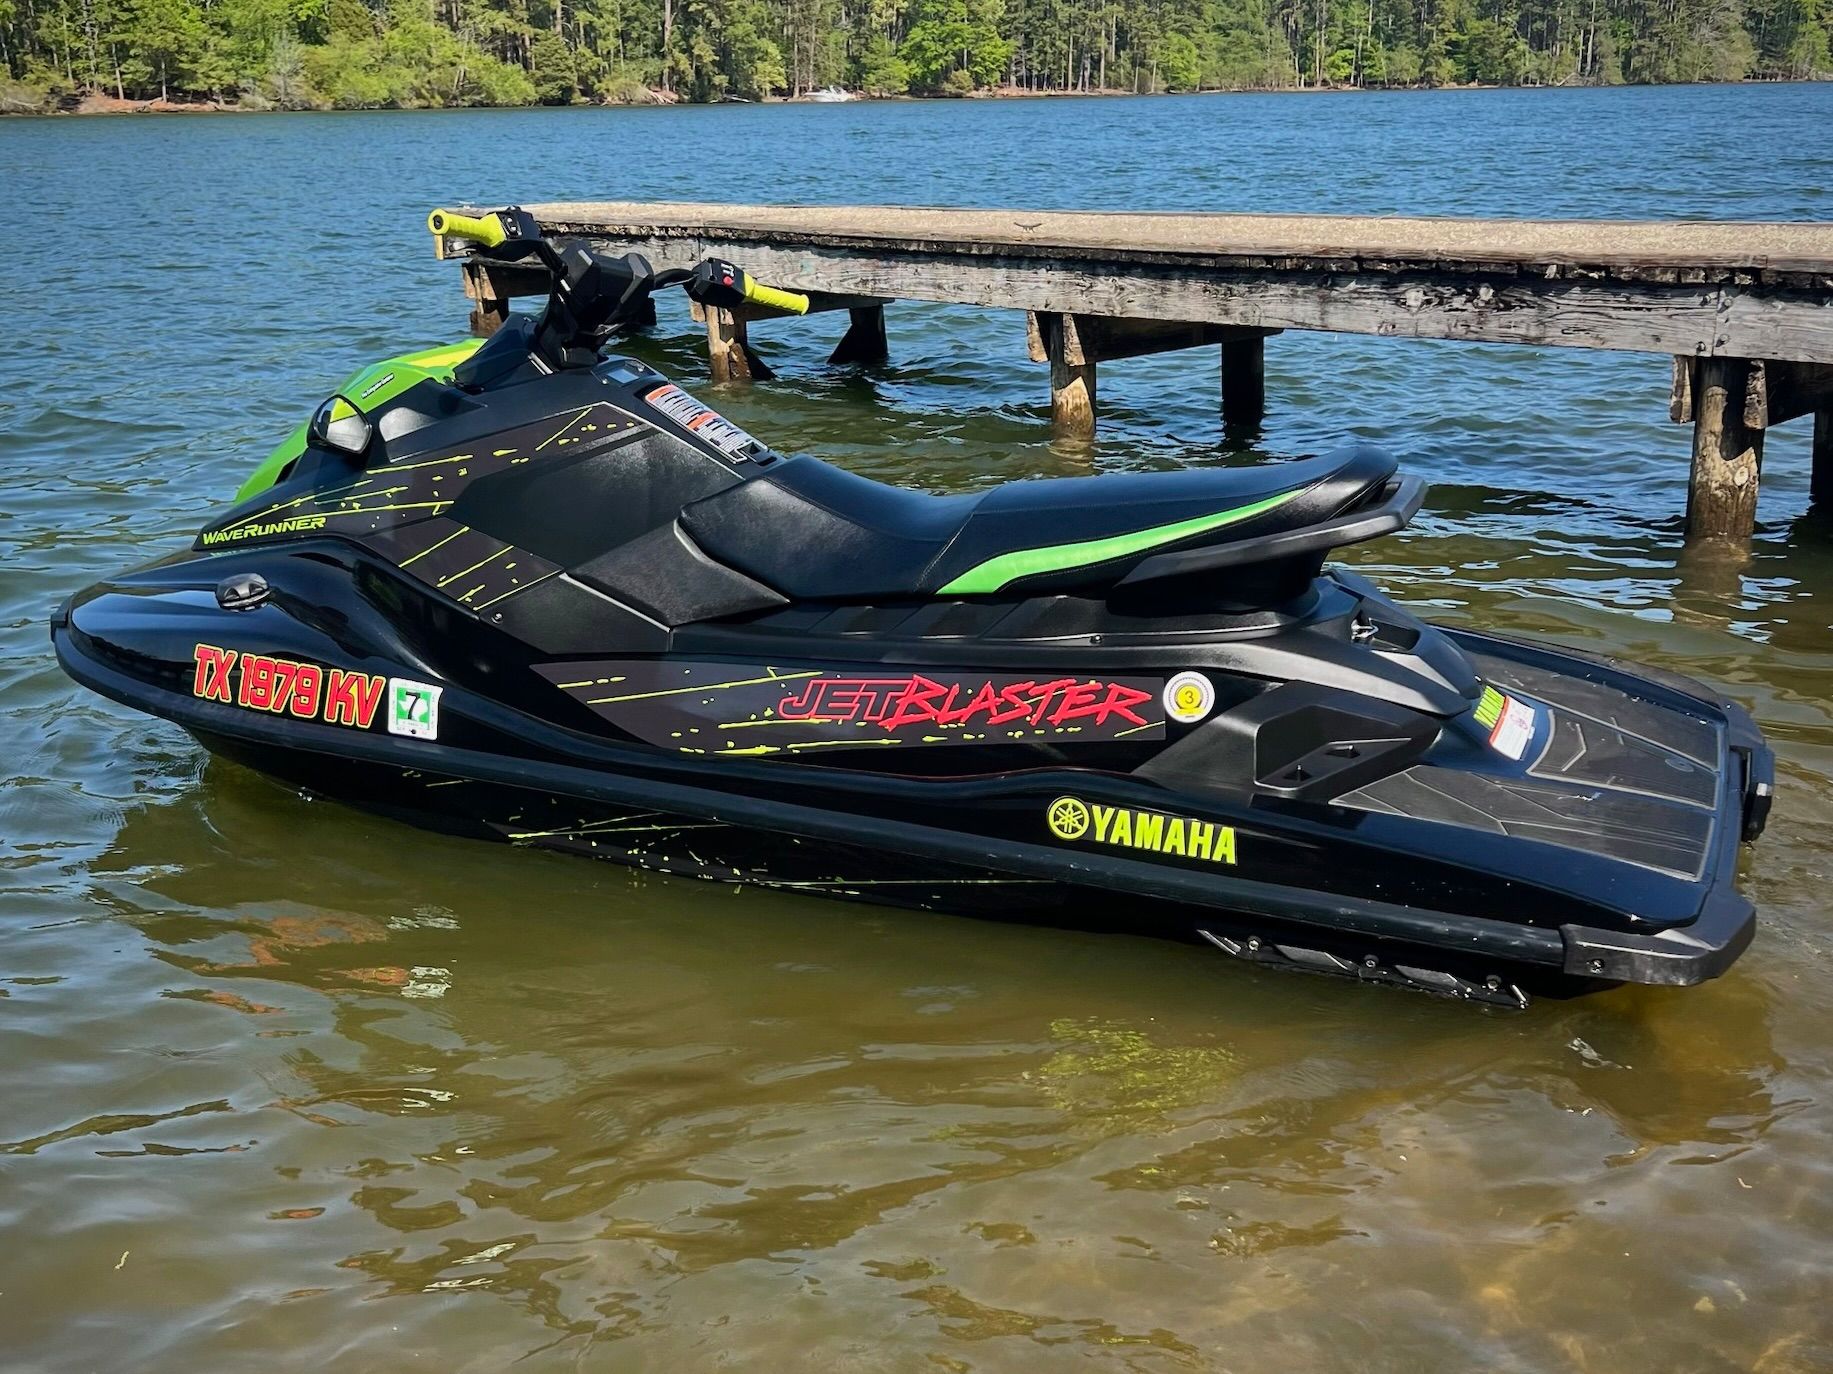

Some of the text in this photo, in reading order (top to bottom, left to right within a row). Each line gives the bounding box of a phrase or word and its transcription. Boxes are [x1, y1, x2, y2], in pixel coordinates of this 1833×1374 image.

[203, 516, 327, 545] WAVERUNNER
[194, 643, 386, 729] TX 1979 KV
[1184, 690, 1194, 705] 3
[404, 691, 421, 720] 7
[1091, 804, 1237, 865] YAMAHA
